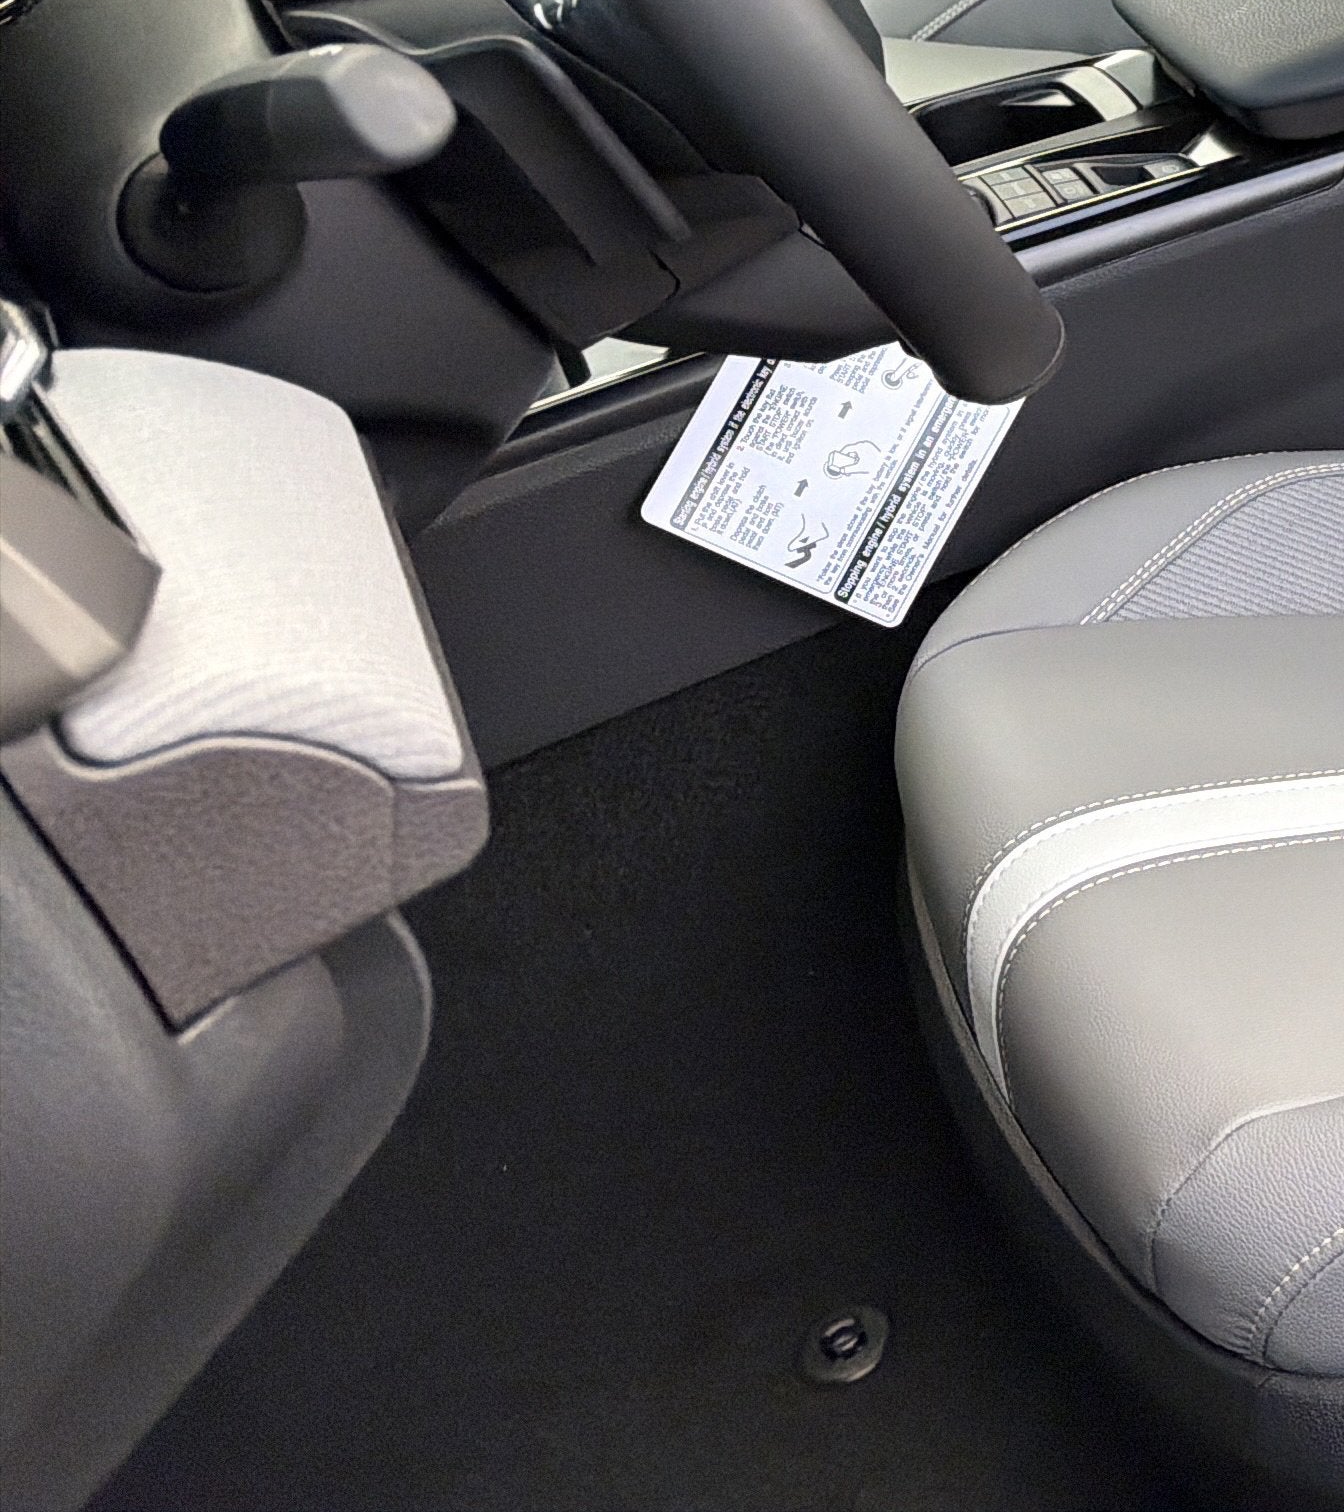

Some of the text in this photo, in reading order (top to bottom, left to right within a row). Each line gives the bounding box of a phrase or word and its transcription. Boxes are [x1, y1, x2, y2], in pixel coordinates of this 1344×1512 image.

[928, 394, 960, 435] emergen
[914, 447, 928, 460] in
[921, 434, 936, 449] an
[895, 459, 923, 494] system
[877, 492, 905, 524] hybrid
[858, 525, 886, 559] engine
[835, 557, 869, 600] Stopping
